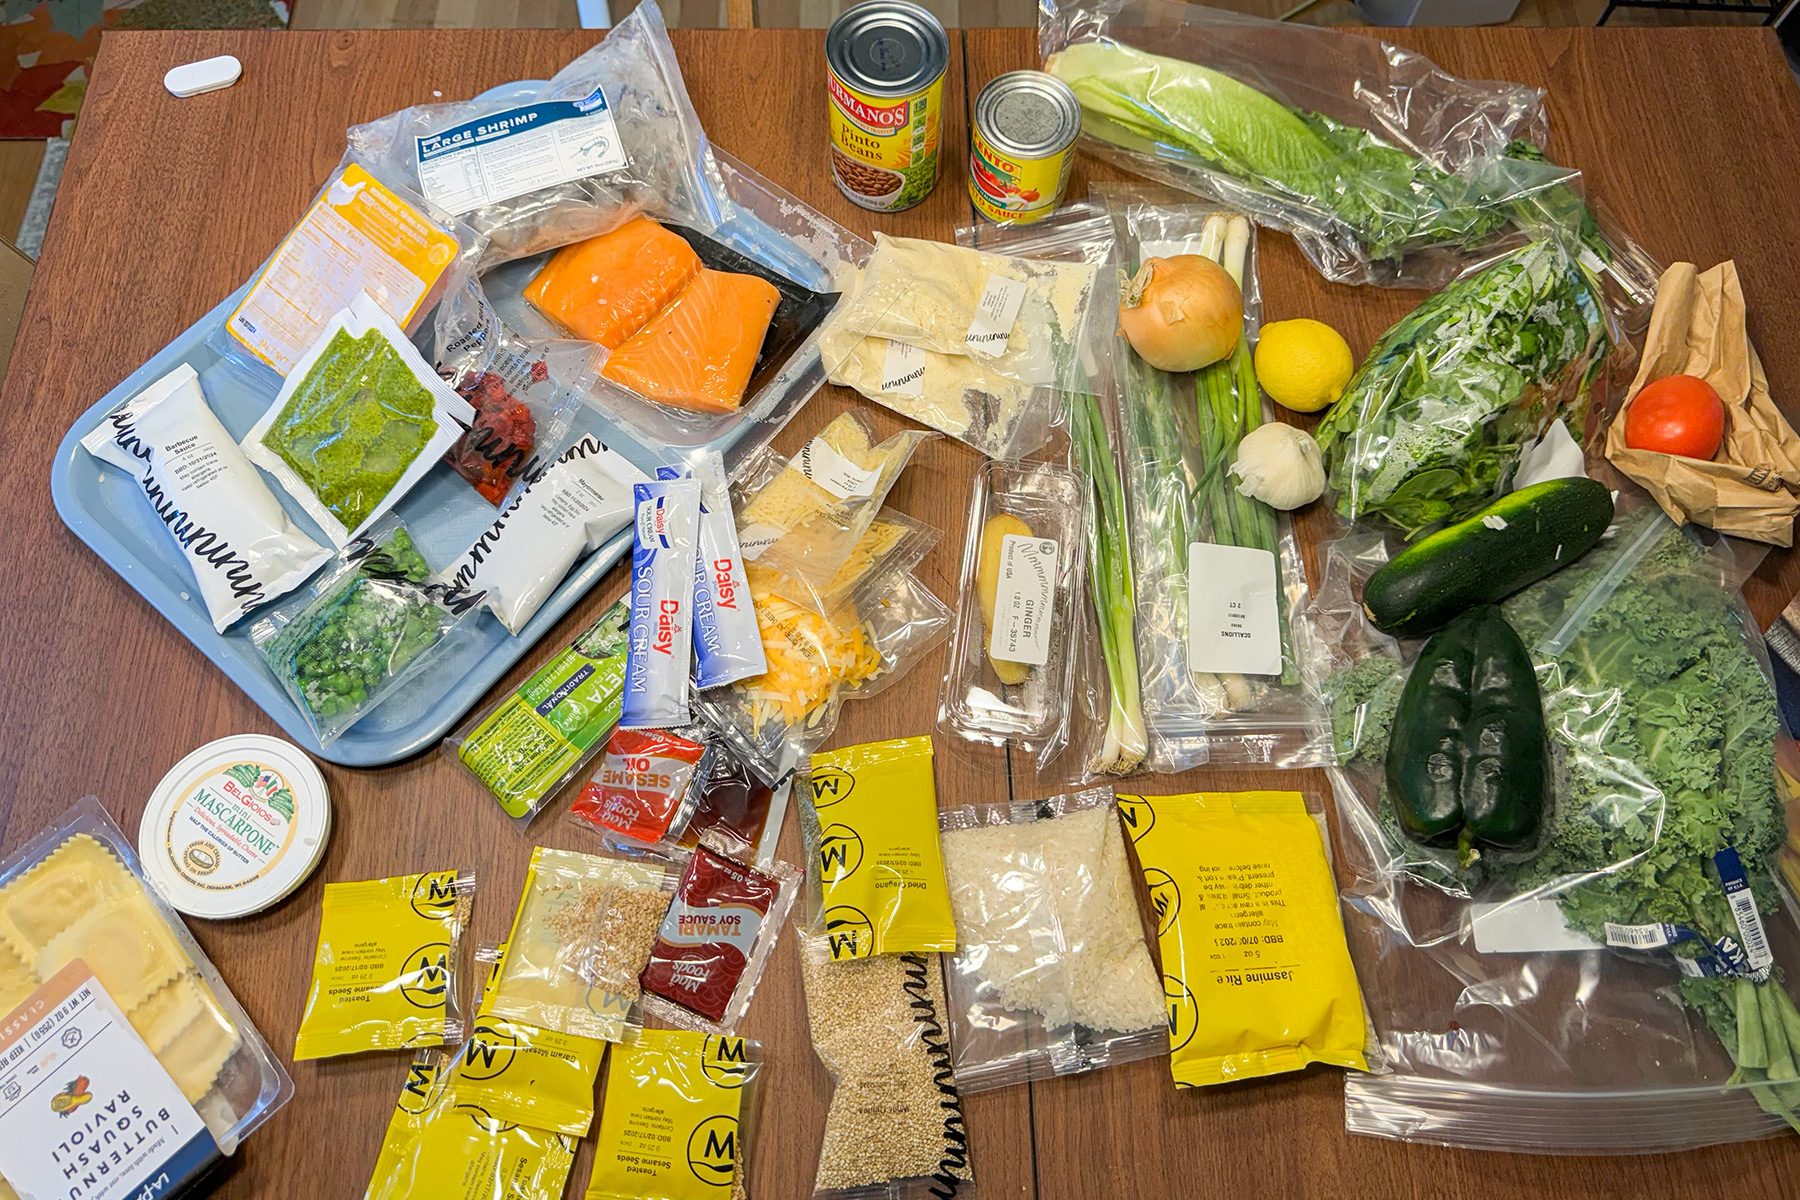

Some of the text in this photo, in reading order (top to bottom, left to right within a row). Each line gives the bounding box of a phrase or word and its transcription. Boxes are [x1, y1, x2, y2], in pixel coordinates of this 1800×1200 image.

[828, 75, 905, 126] URMANO'S
[422, 130, 472, 154] LARGE
[477, 112, 538, 137] SHRIMP
[842, 122, 880, 149] Pinto
[841, 132, 882, 160] Beans
[988, 204, 1024, 220] SAUCE
[446, 320, 483, 354] Roasted
[463, 318, 492, 352] Peppers
[164, 434, 198, 452] Barbecue
[174, 442, 196, 454] Sauce
[188, 451, 217, 467] 10/31/2024
[577, 477, 605, 502] Mayonnaise
[655, 507, 665, 534] Daisy
[645, 523, 655, 542] CREAM
[1007, 540, 1015, 560] Product
[709, 557, 739, 612] Daisy
[692, 547, 721, 653] OUR CREAM
[1013, 600, 1019, 608] OZ
[652, 599, 679, 656] Daisy
[1022, 599, 1034, 638] GINGER
[630, 566, 653, 693] SOUR CREAM
[540, 663, 589, 716] TRADITIONAL
[584, 658, 633, 710] FETA
[602, 767, 671, 790] SESAME
[813, 778, 838, 799] M
[223, 780, 280, 826] BELGIOIOS
[231, 803, 251, 821] mini
[193, 787, 275, 856] MASCARPONE
[188, 816, 250, 864] HALF THE CALORIES OF BUTTER
[194, 807, 218, 827] Delicious,
[214, 823, 243, 847] Spreadable
[241, 843, 258, 858] Cheese
[821, 844, 847, 872] M
[874, 880, 926, 889] Dried Oregano
[677, 911, 741, 928] SOY SAUCE
[677, 916, 741, 943] TAMARI
[828, 930, 857, 960] M
[1260, 934, 1283, 943] BBD:
[1254, 950, 1260, 958] 5
[1715, 936, 1744, 965] KA
[334, 963, 367, 972] 02/17/2025
[1216, 970, 1293, 985] Jasmine Rice
[76, 987, 92, 1001] NET
[328, 986, 351, 995] Seeds
[338, 994, 369, 1003] Toasted
[61, 1006, 70, 1015] 9
[66, 997, 80, 1010] WT
[0, 1000, 45, 1041] CLASSI
[52, 1009, 65, 1022] OZ
[6, 1043, 26, 1061] KEEP
[521, 1046, 576, 1063] Garam Masala
[717, 1036, 745, 1064] M
[52, 1090, 131, 1163] RAVIOLI
[623, 1129, 655, 1139] 02/17/2025
[63, 1104, 144, 1180] SQUASH
[144, 1135, 166, 1154] Made
[704, 1130, 734, 1160] M
[68, 1107, 170, 1200] BUTTERNU
[131, 1150, 148, 1166] with
[615, 1154, 671, 1169] Sesame Seeds
[117, 1161, 136, 1178] love,
[626, 1165, 656, 1176] Toasted
[93, 1184, 111, 1200] with
[106, 1175, 121, 1188] eat
